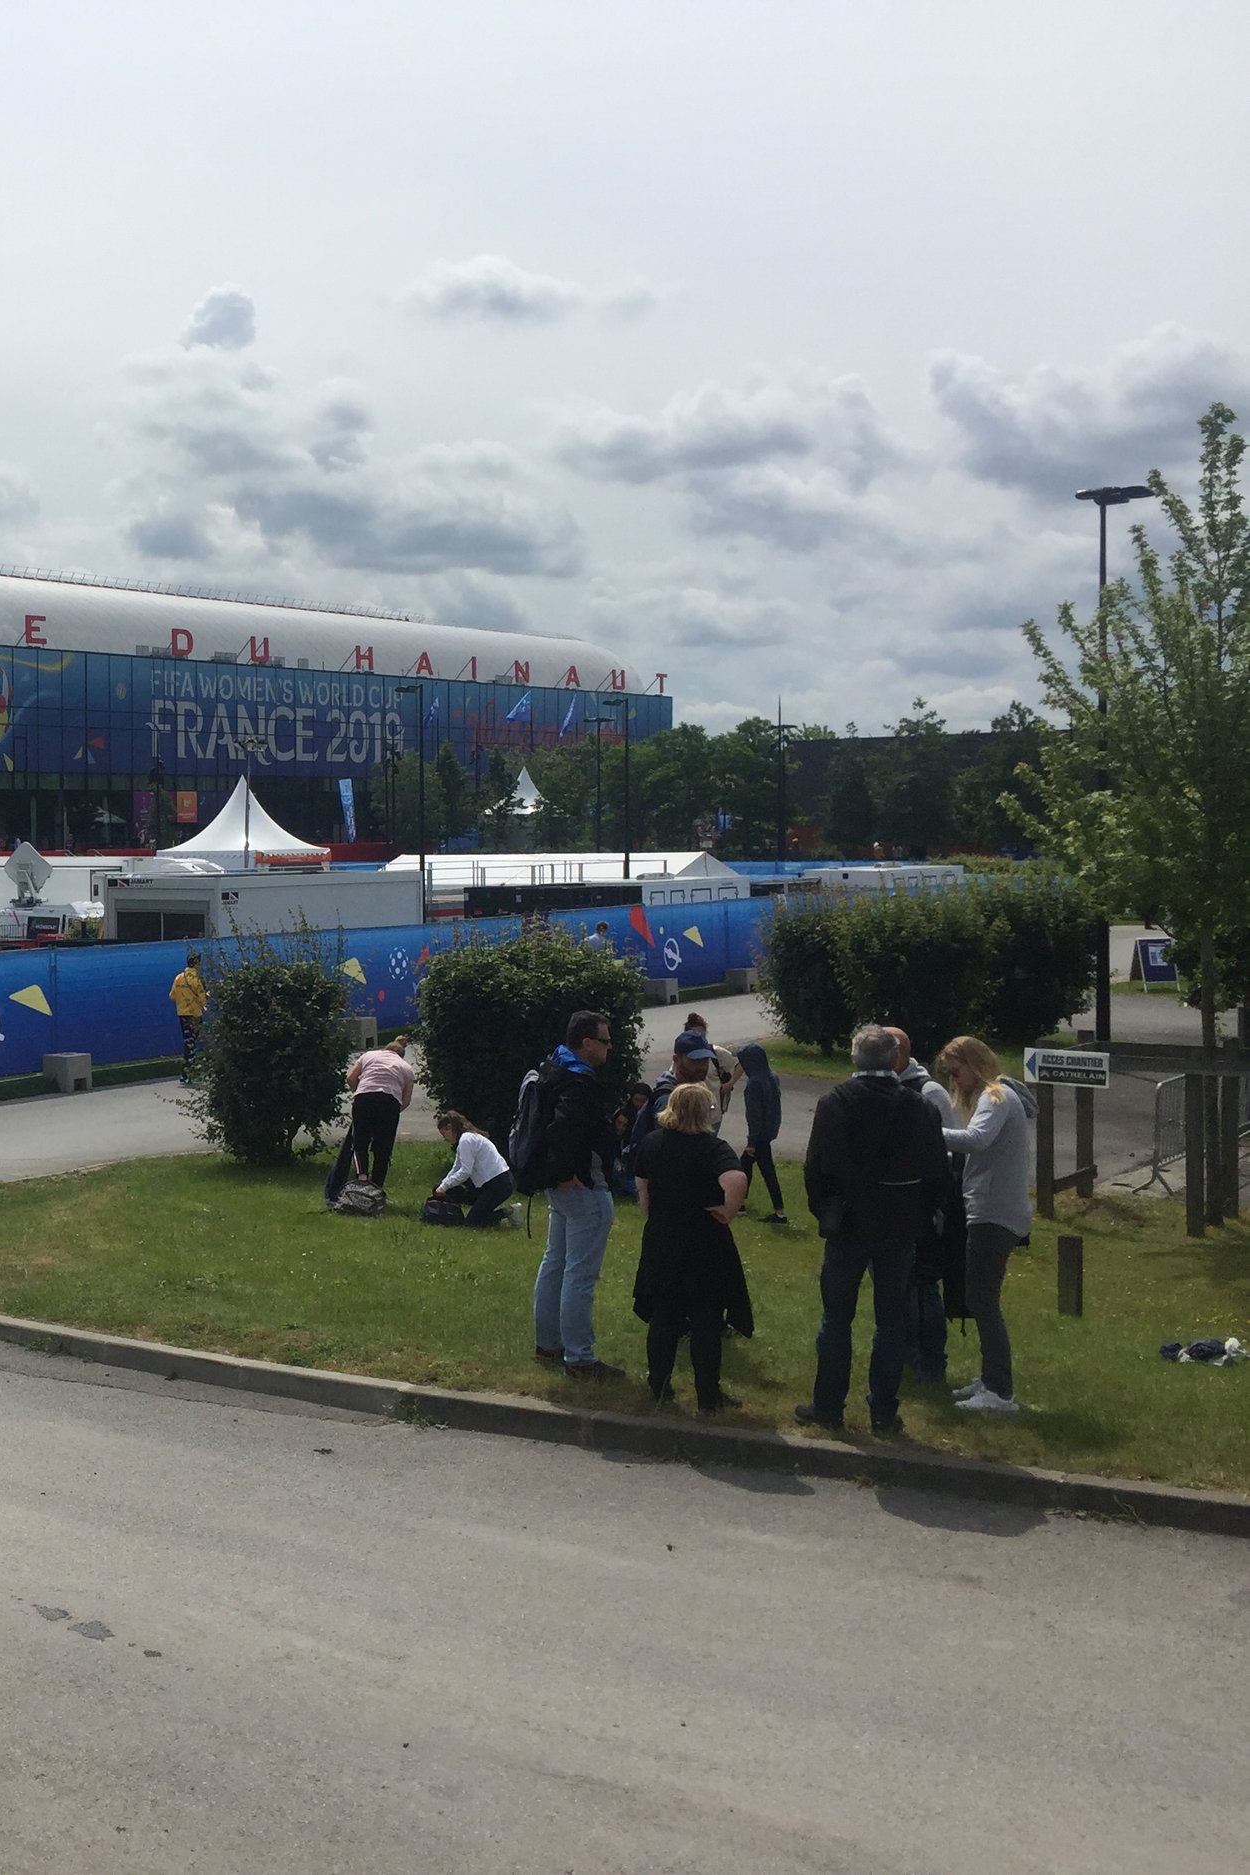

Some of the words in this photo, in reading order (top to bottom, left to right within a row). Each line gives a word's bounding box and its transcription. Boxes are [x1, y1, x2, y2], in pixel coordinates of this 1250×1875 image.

[150, 669, 196, 698] FIFA
[199, 672, 294, 705] WOMEN'S
[298, 680, 365, 708] WORLD
[171, 628, 270, 664] DU
[355, 645, 668, 693] HAINAUT
[145, 699, 319, 766] FRANCE
[325, 708, 405, 764] 2019
